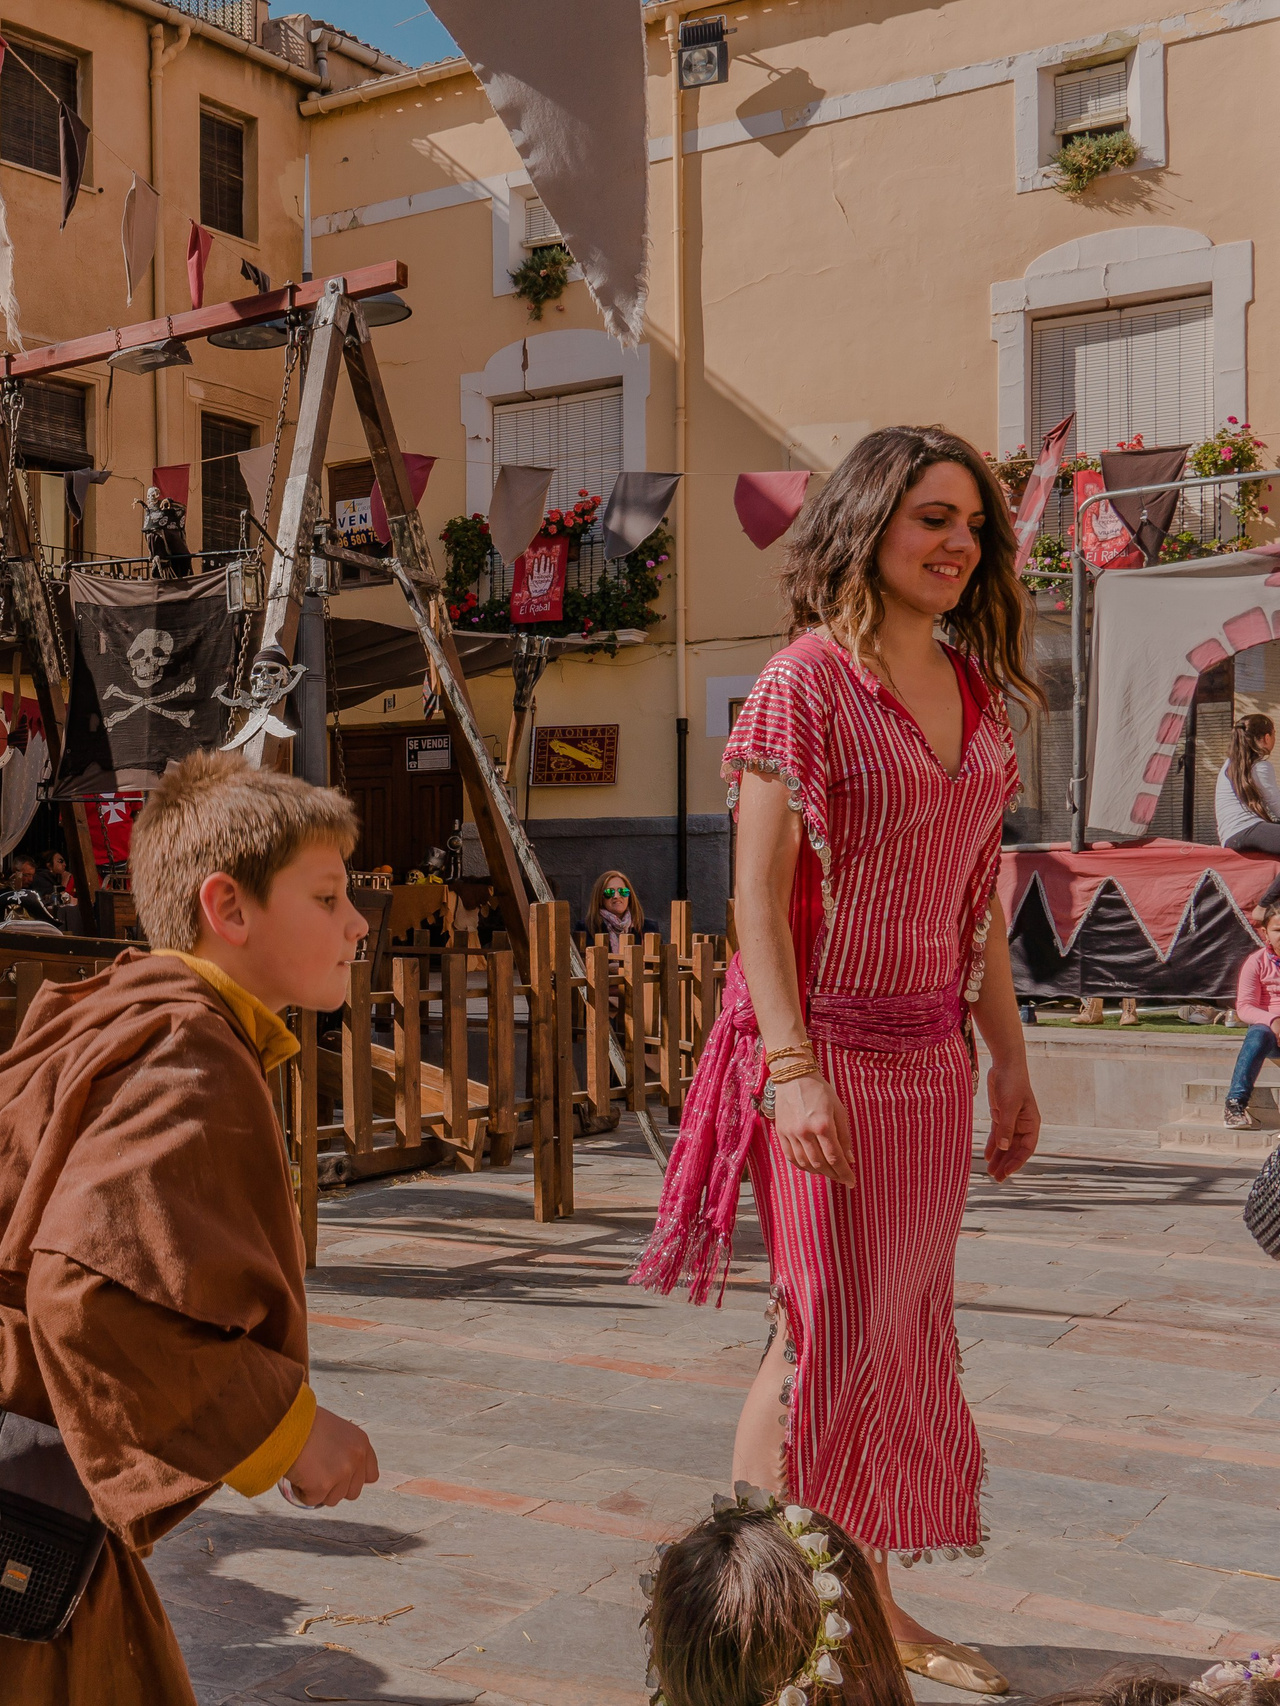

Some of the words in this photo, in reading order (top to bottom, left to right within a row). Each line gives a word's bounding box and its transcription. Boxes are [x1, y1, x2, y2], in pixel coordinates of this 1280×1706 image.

[338, 513, 368, 528] VEN
[350, 533, 367, 546] 580
[1085, 551, 1097, 562] El
[519, 605, 528, 615] El
[529, 602, 551, 616] Rabal
[554, 728, 602, 737] MONTA
[408, 740, 419, 750] SE
[421, 738, 448, 749] VENDE
